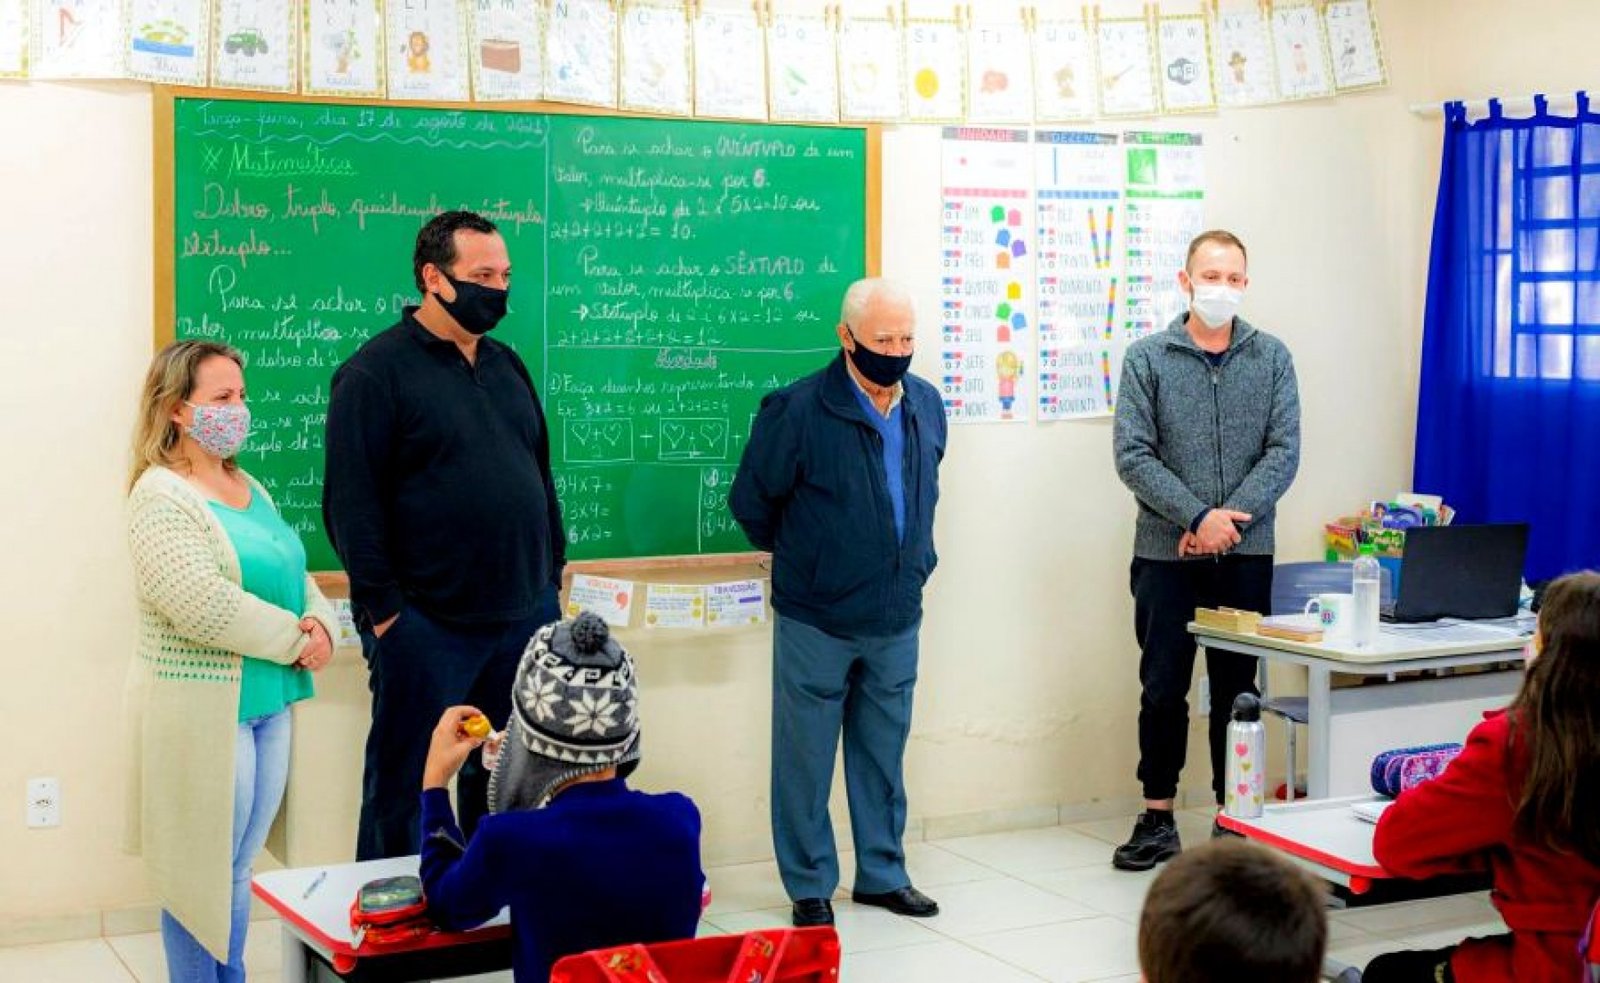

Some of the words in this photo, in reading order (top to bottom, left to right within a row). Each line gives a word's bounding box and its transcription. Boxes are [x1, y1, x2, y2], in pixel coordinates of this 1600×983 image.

[357, 108, 374, 127] 17
[577, 125, 615, 155] Para
[577, 245, 622, 276] Para
[210, 264, 265, 313] Para
